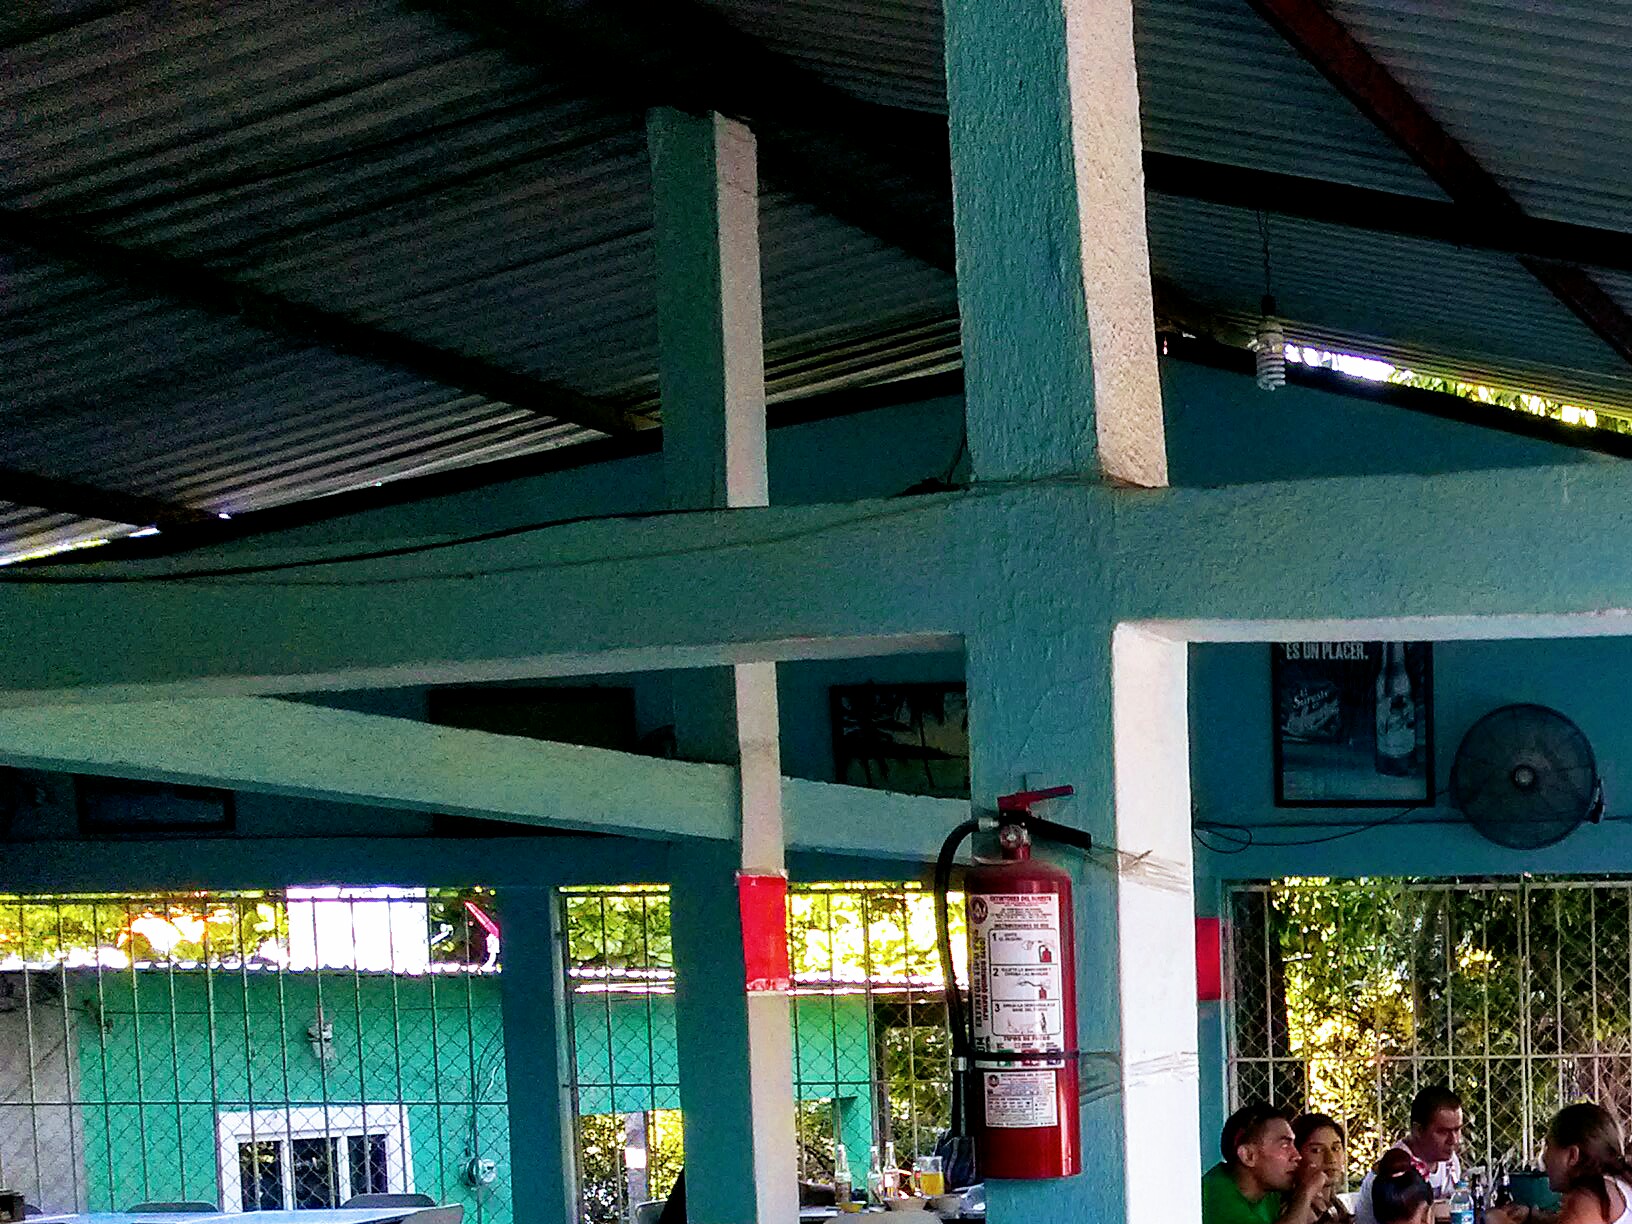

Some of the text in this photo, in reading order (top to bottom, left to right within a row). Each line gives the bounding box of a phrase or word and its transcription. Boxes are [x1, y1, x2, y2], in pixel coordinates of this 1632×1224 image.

[1286, 641, 1300, 660] ES
[1303, 641, 1320, 660] UN
[992, 933, 997, 941] 1
[993, 968, 999, 977] 2
[994, 1004, 1000, 1013] 3
